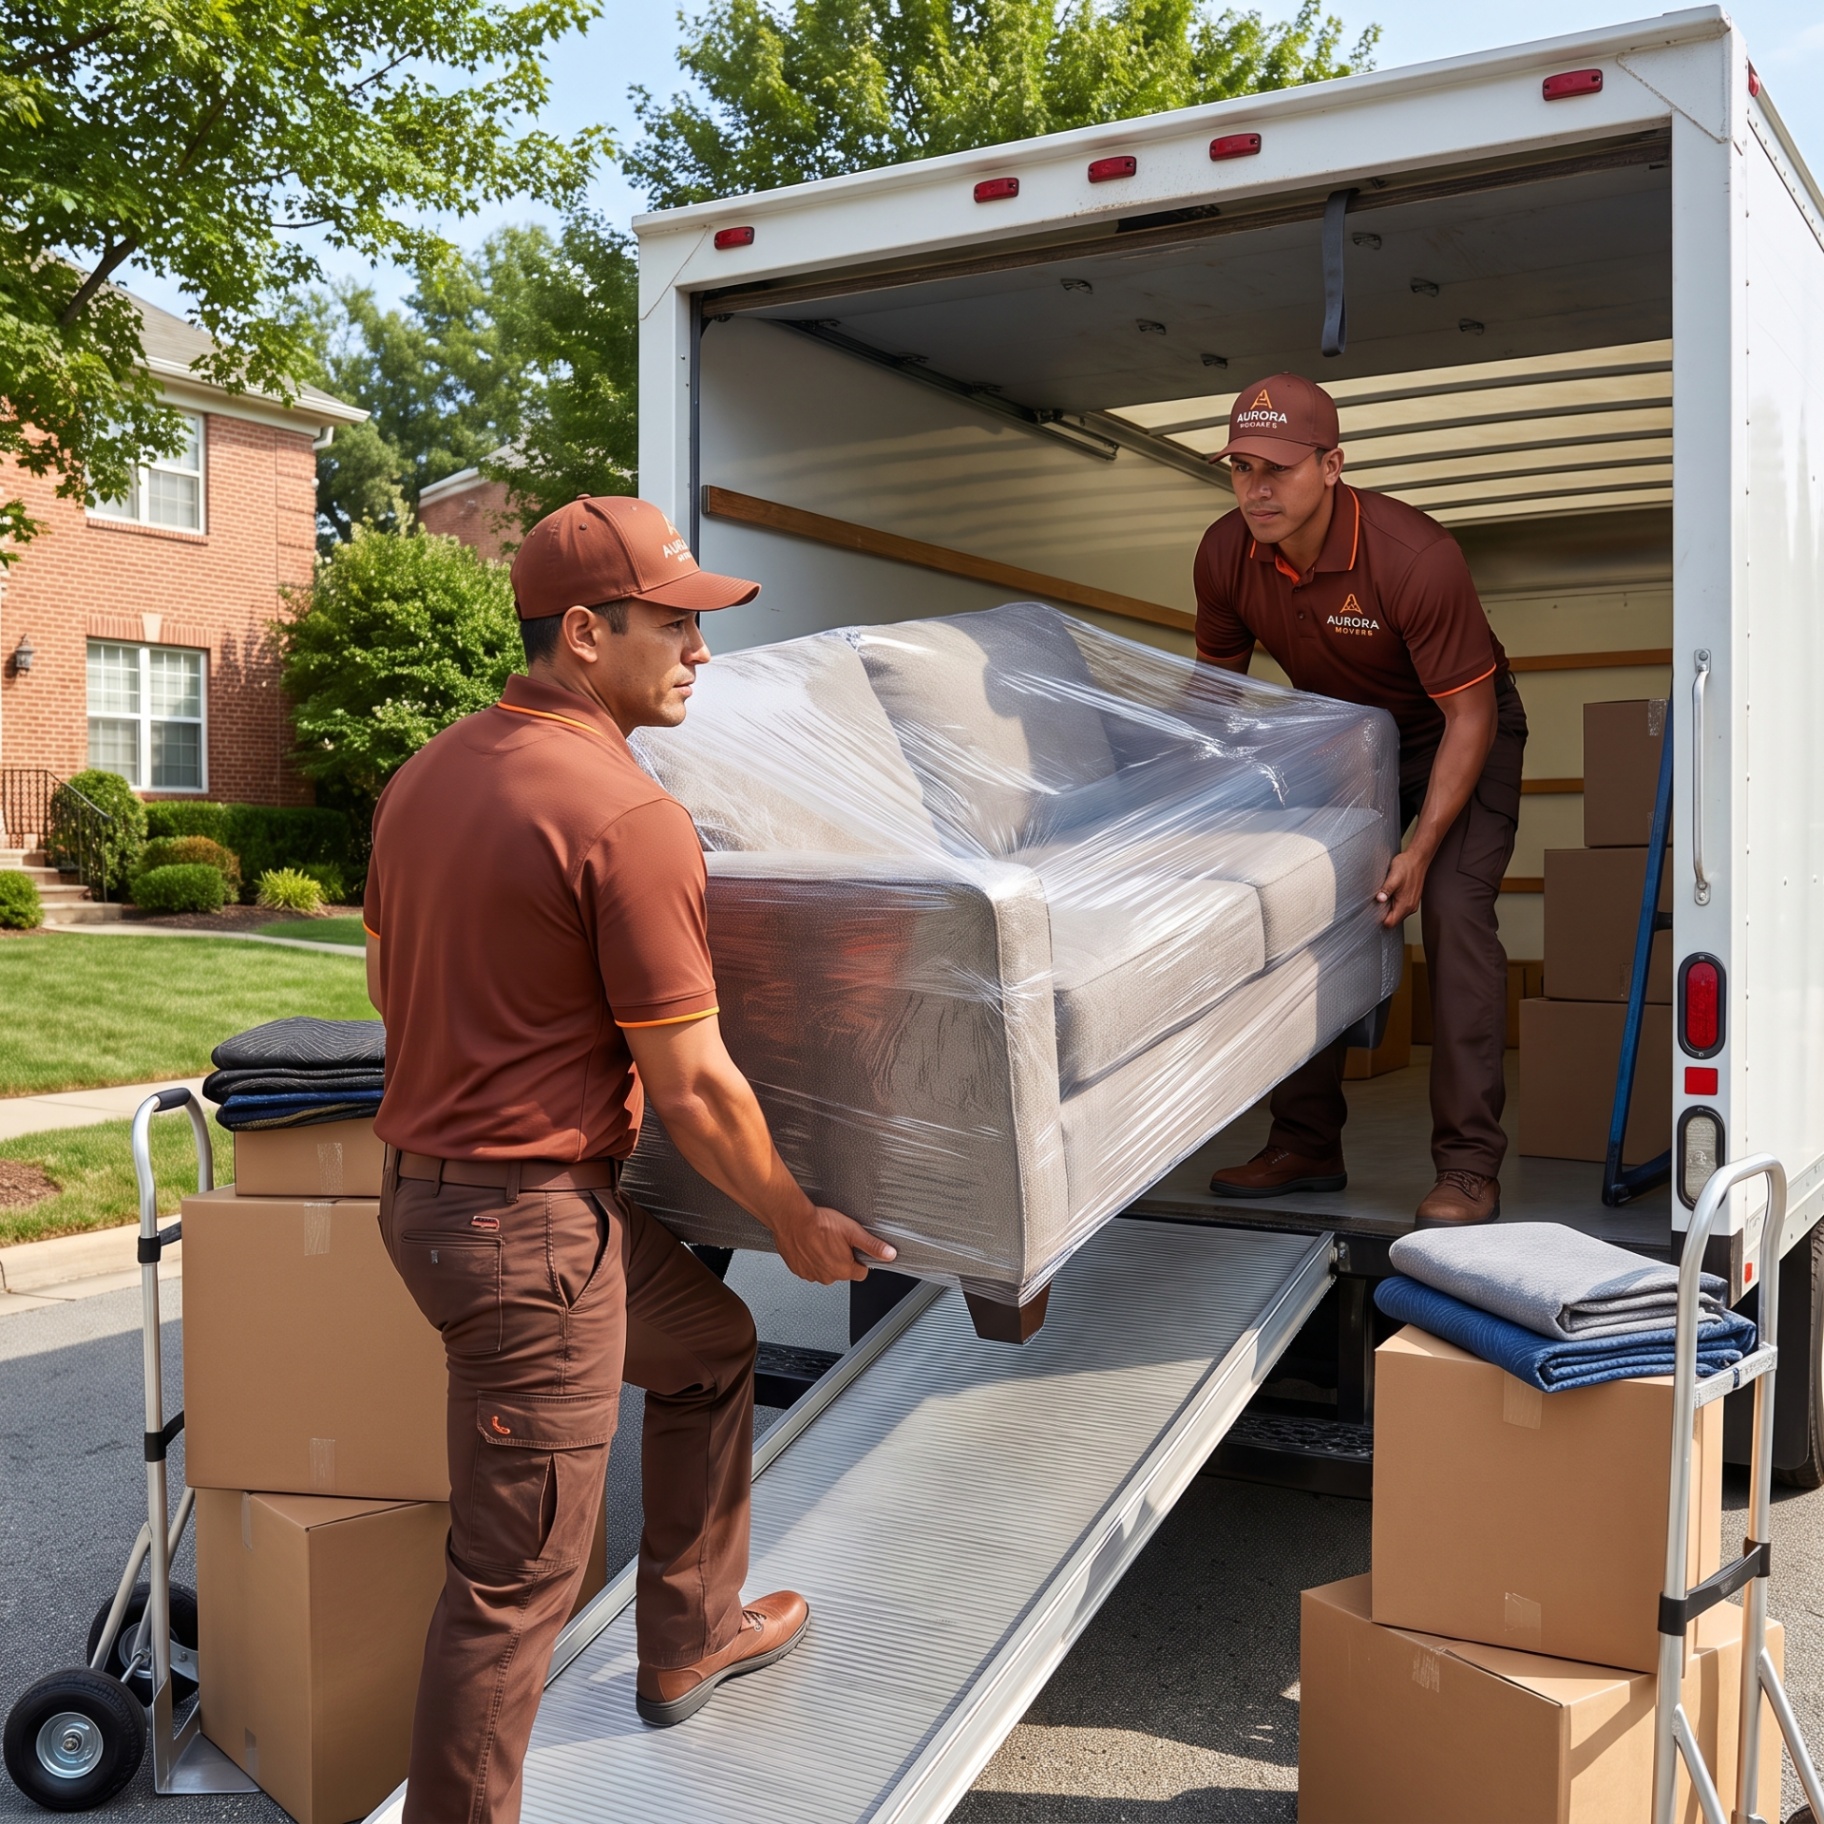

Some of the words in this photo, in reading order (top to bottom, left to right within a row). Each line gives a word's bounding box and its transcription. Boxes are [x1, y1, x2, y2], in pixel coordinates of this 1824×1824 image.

[1236, 410, 1288, 424] AURORA
[1326, 615, 1380, 630] AURORA
[1335, 626, 1373, 637] MOVERS
